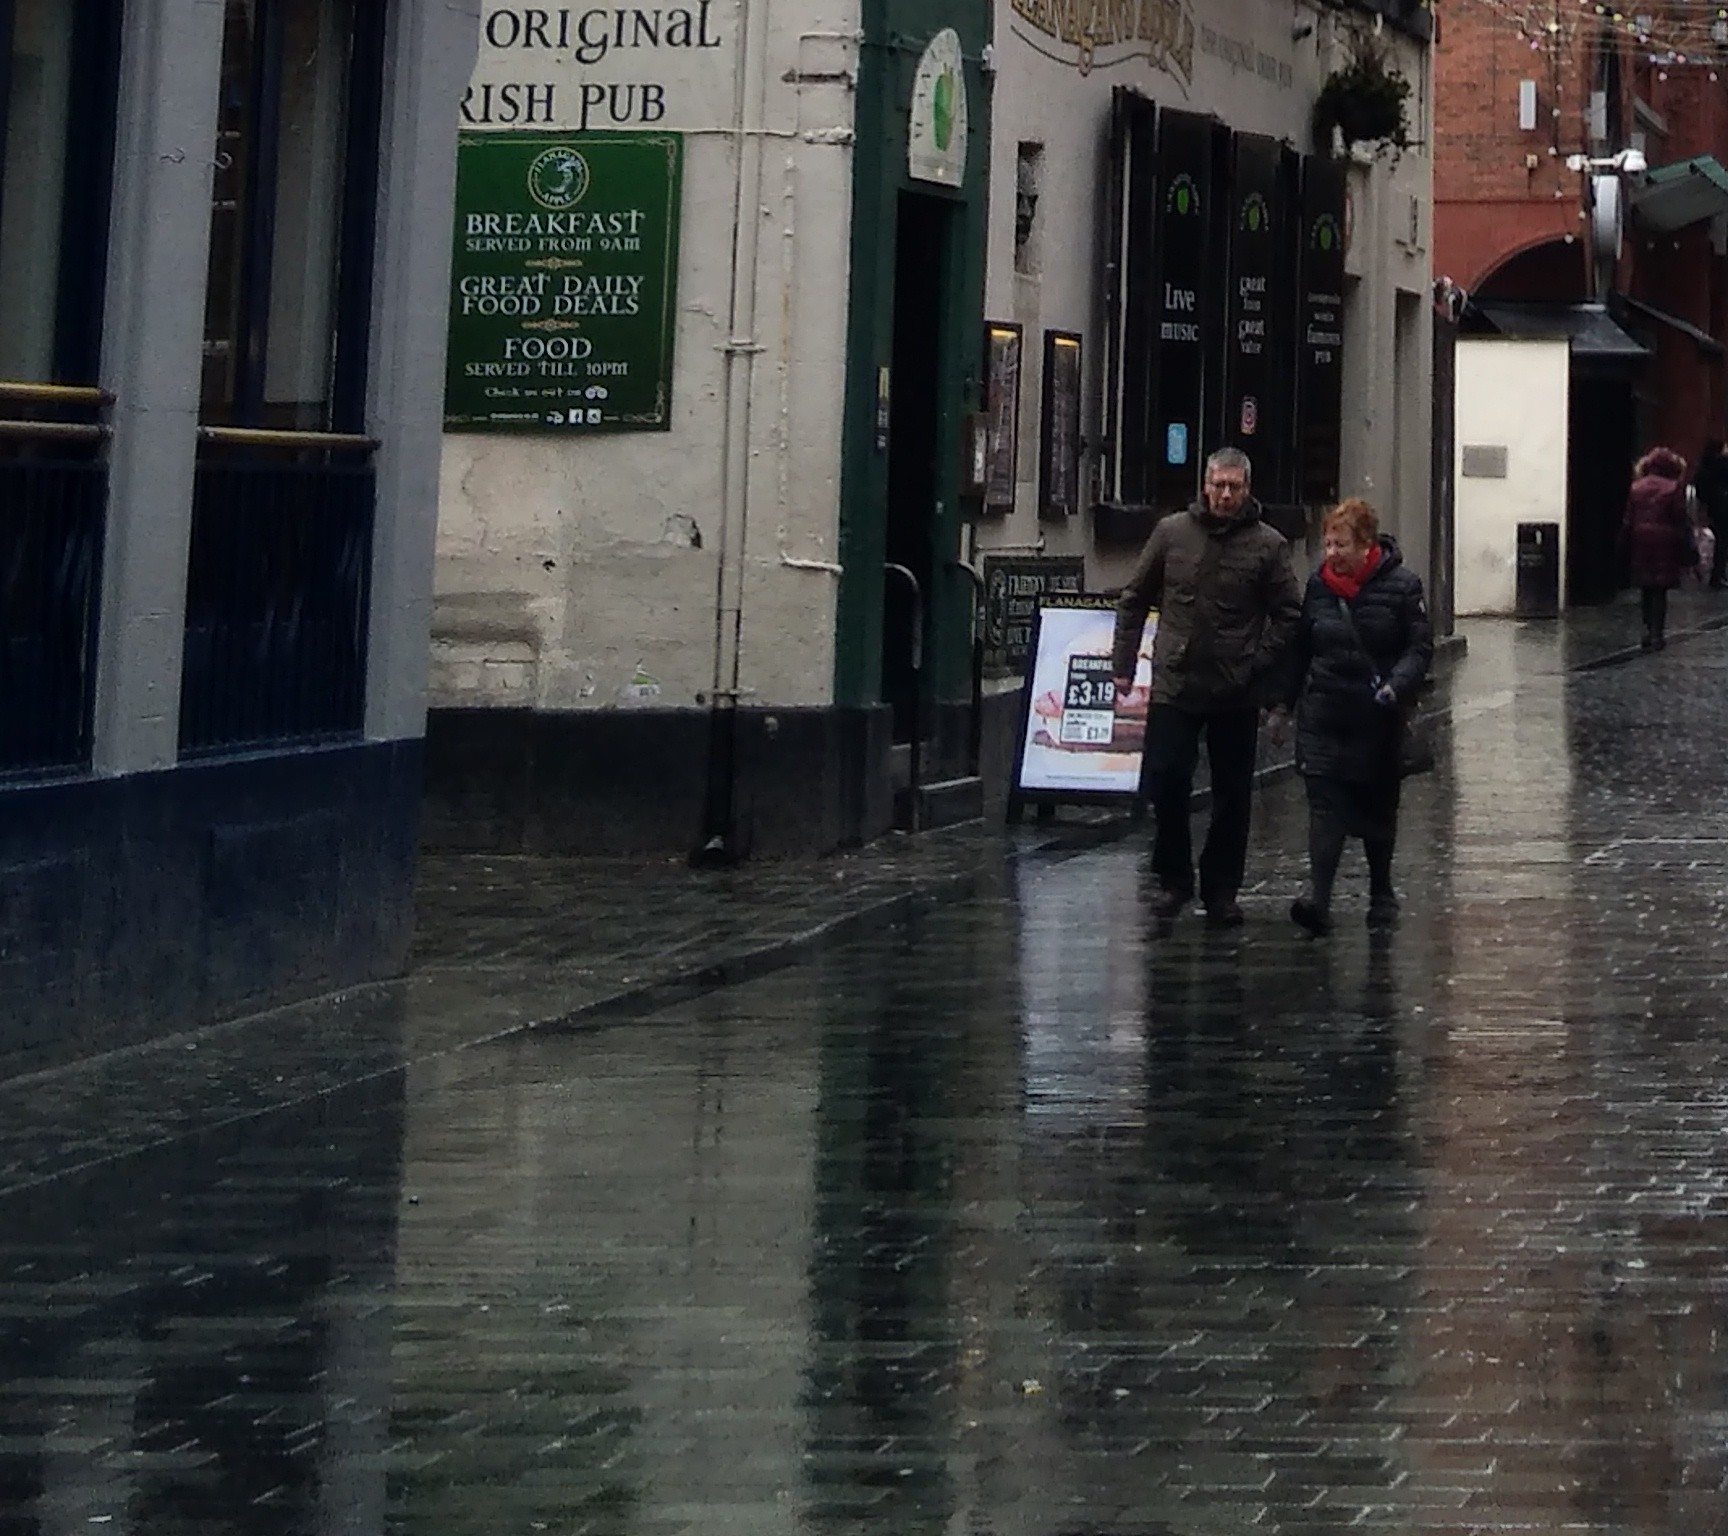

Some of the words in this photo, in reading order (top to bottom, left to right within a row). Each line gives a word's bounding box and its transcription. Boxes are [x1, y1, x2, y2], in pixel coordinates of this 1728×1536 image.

[459, 84, 554, 123] RISH
[579, 83, 667, 129] PUB
[466, 209, 646, 235] BREAKFAST
[466, 237, 531, 252] SERVED
[539, 236, 592, 252] FROM
[600, 236, 641, 251] 9AM
[460, 272, 550, 295] GREAT
[563, 274, 645, 295] DAILY
[462, 295, 541, 316] FOOD
[553, 295, 640, 316] DEALS
[504, 337, 593, 360] FOOD
[465, 362, 531, 377] SERVED
[538, 360, 578, 376] TILL
[587, 361, 629, 376] 10PM
[1067, 680, 1115, 706] £3.19
